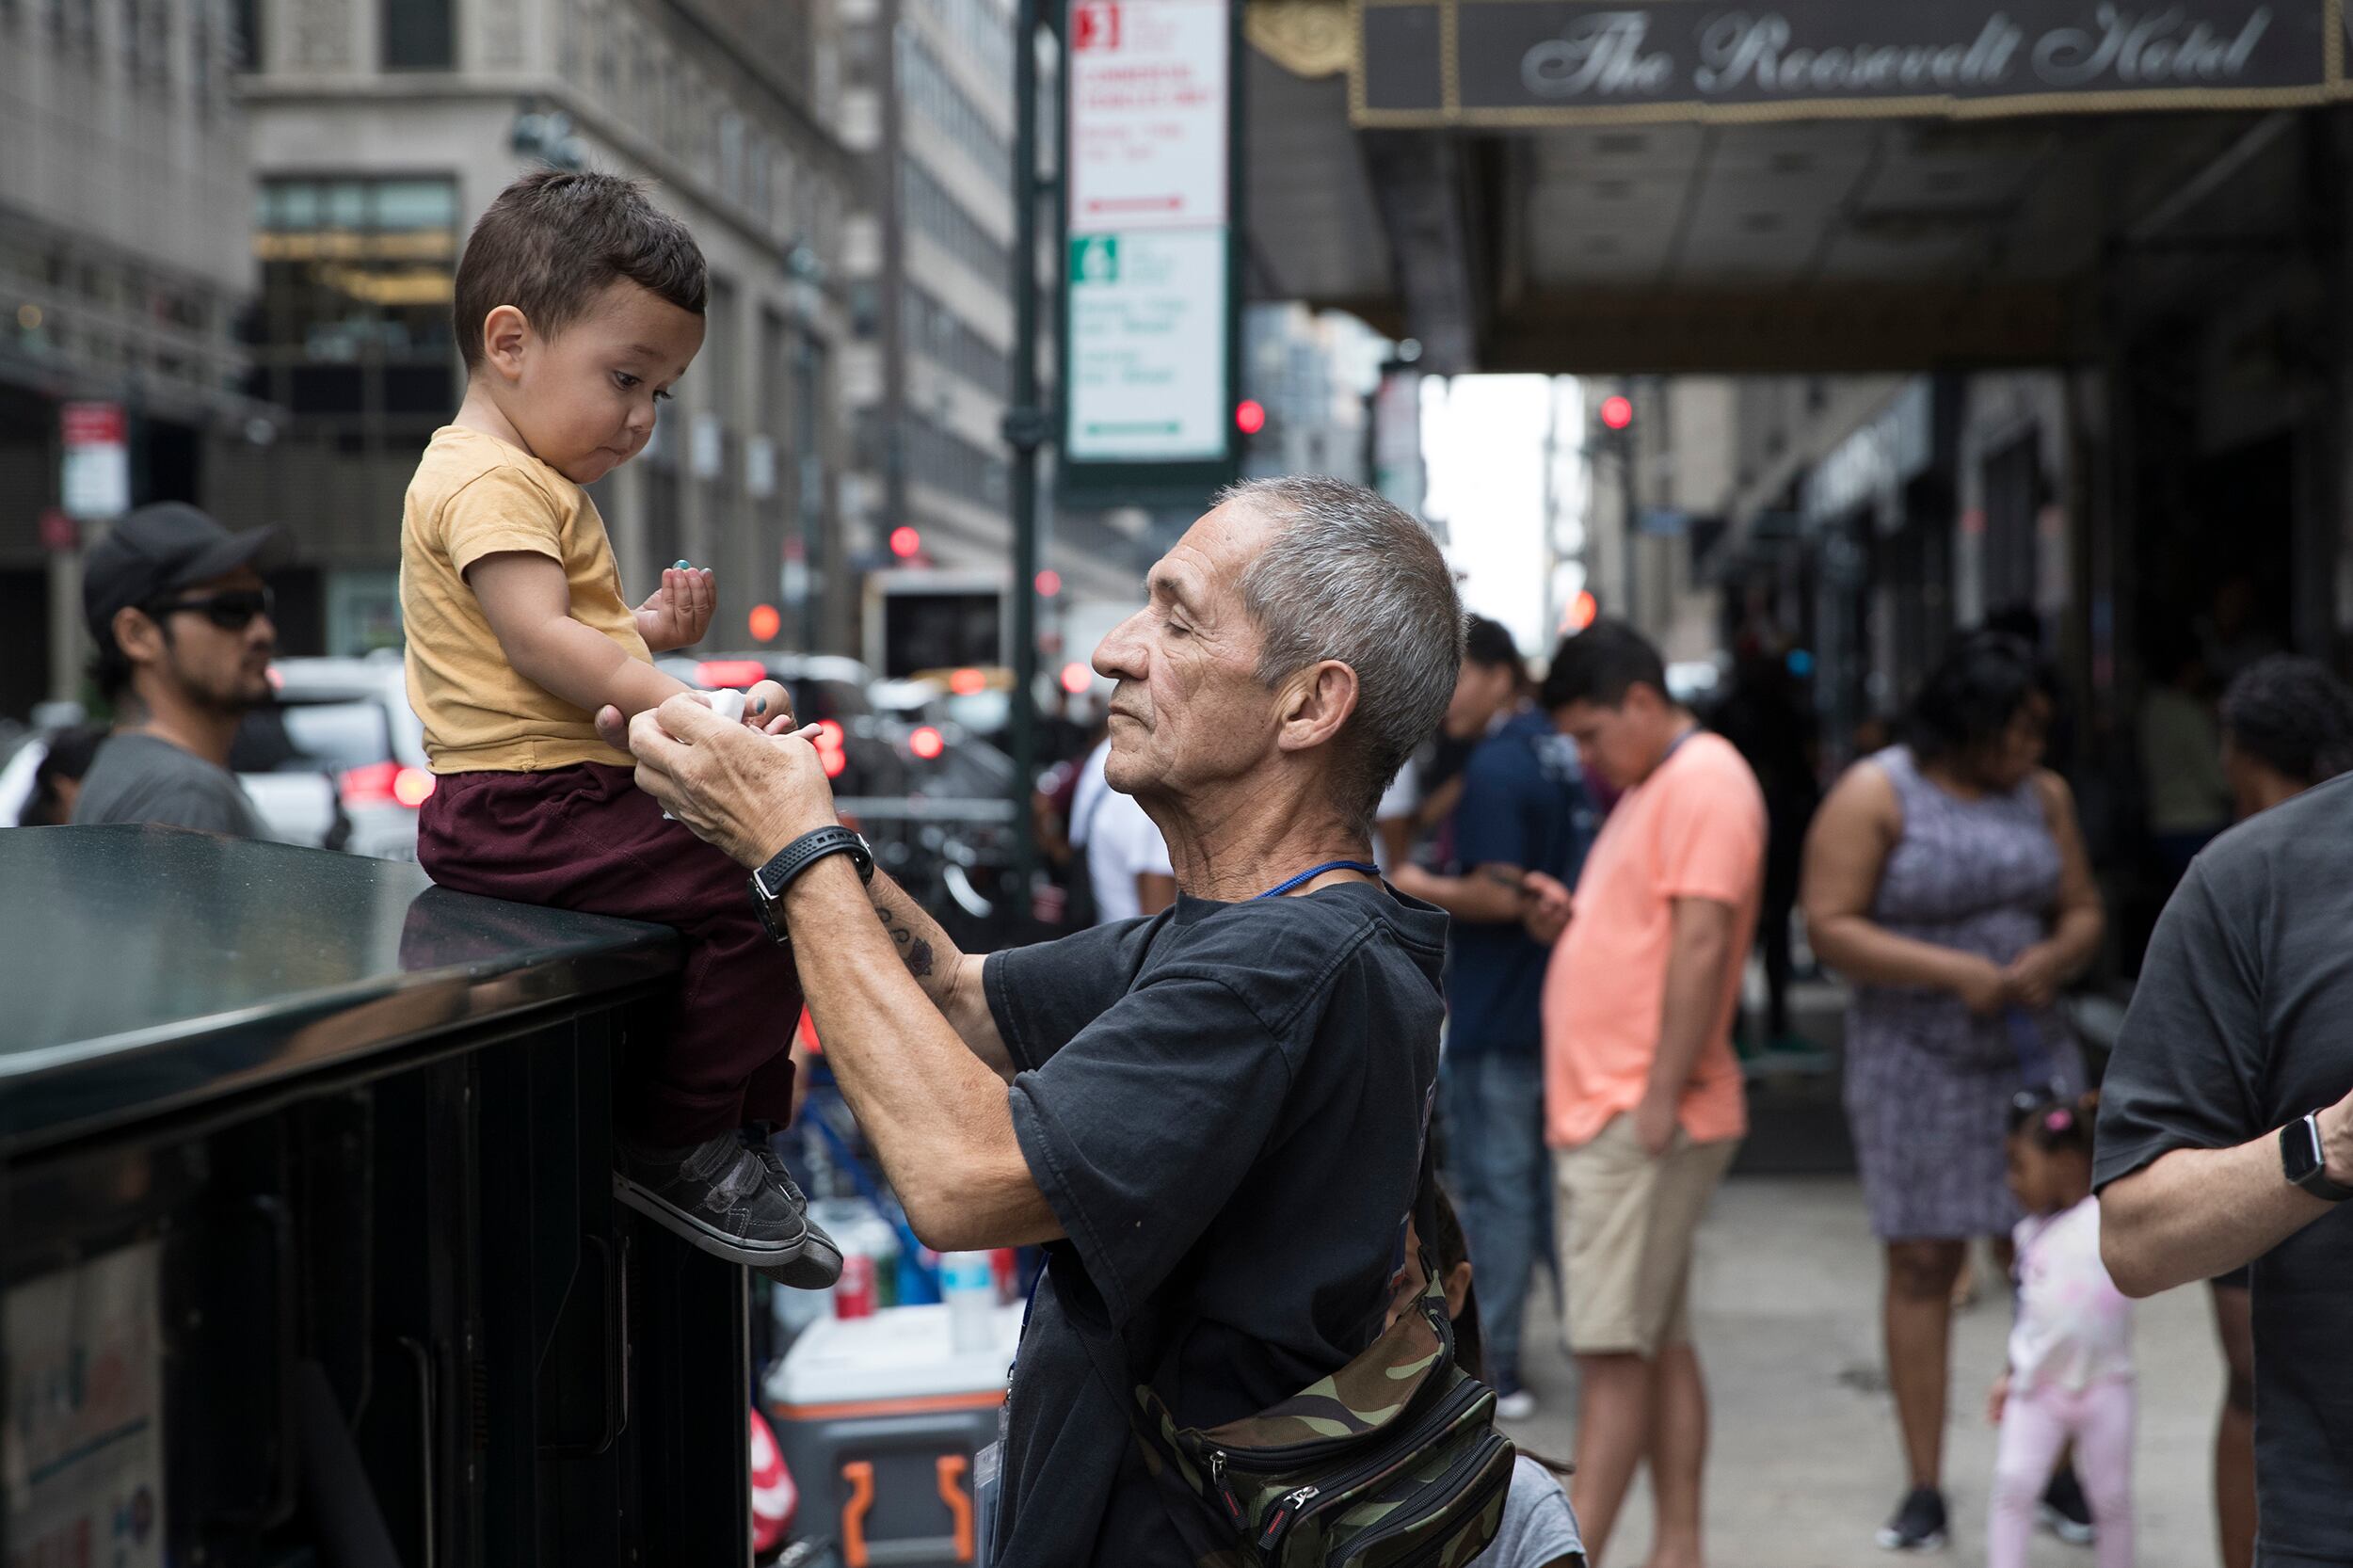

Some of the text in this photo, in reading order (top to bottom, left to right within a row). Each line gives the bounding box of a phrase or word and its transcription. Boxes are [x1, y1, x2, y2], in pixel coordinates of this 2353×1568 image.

[1520, 1, 2274, 95] The Roosevelt Hotel
